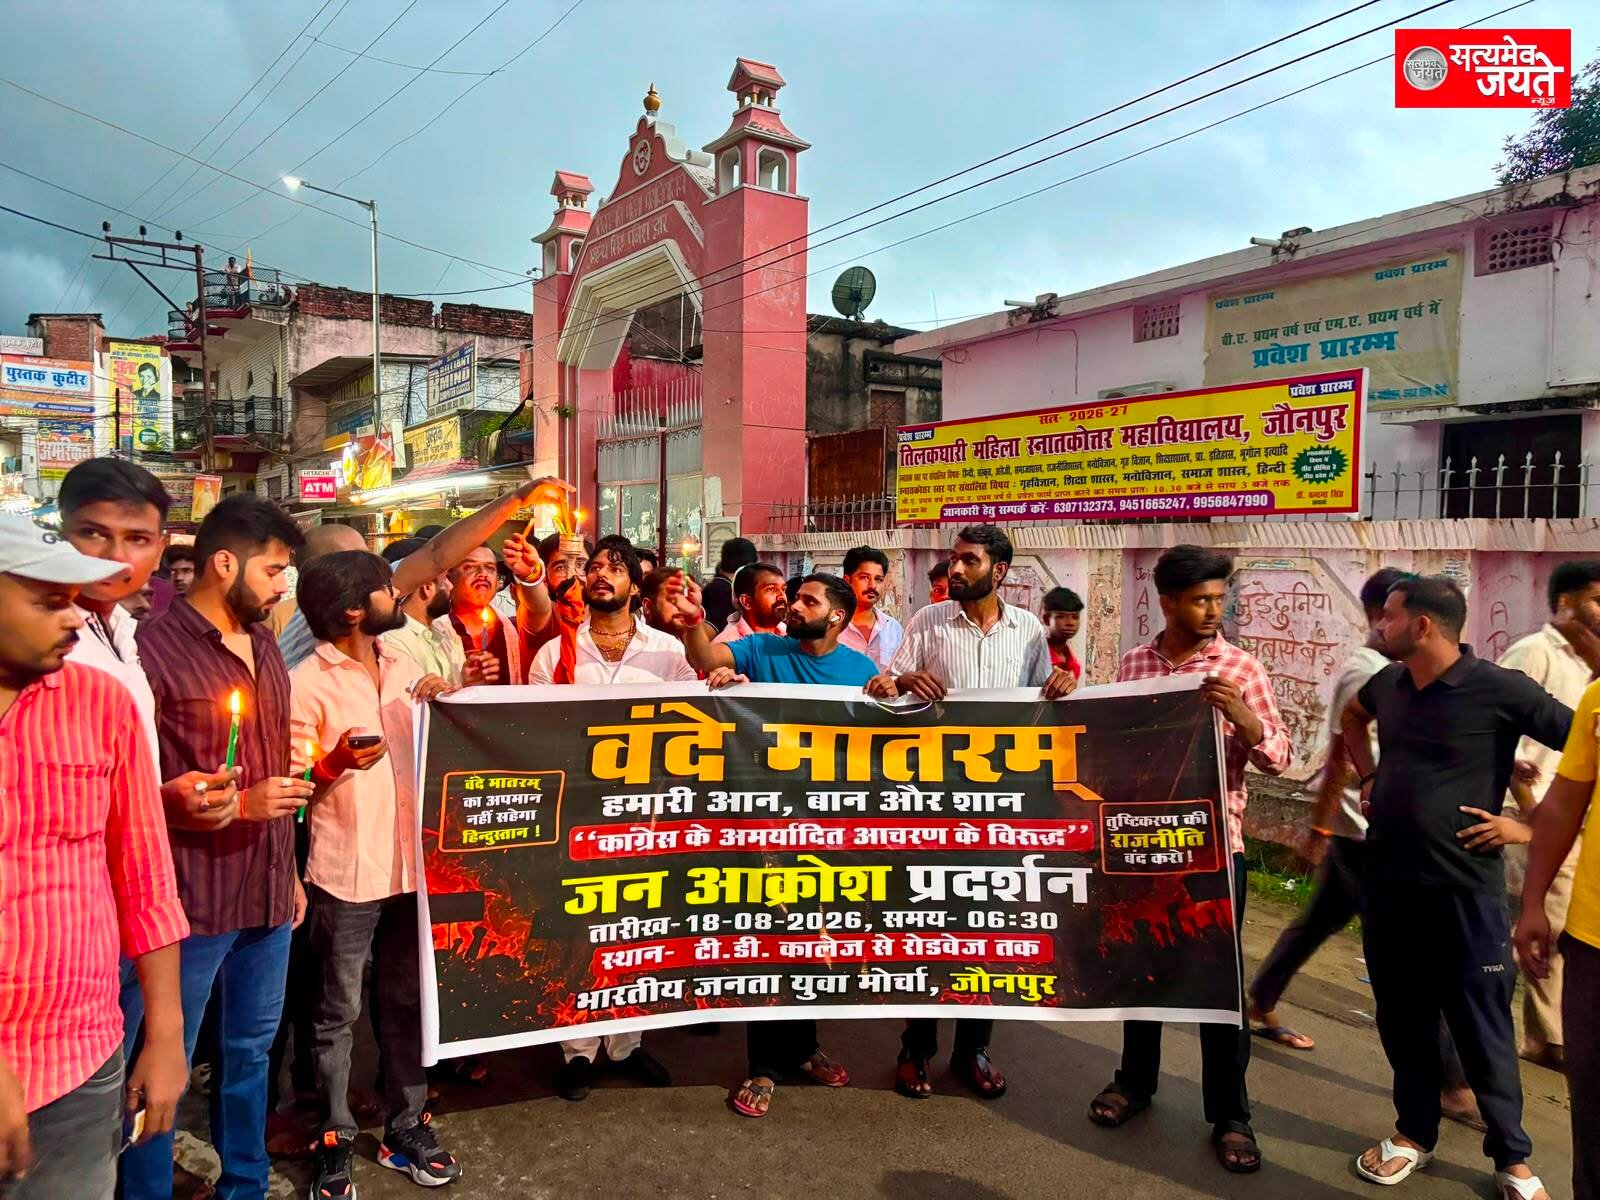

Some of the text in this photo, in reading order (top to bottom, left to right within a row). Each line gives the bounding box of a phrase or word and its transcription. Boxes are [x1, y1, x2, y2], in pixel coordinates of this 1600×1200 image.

[1252, 342, 1311, 369] प्रवेश
[5, 366, 88, 386] पुस्तक कुटीर
[1290, 383, 1316, 397] प्रवेश
[1069, 406, 1128, 421] 2026-27
[972, 434, 1021, 460] महिला
[1027, 425, 1114, 456] स्नातकोत्तर
[1120, 415, 1250, 446] महाविद्यालय,
[1262, 403, 1349, 441] जौनपुर
[1181, 468, 1213, 479] समाज
[1257, 461, 1286, 475] हिन्दी
[304, 482, 333, 493] ATM
[943, 505, 979, 517] जानकारी
[982, 504, 995, 518] हेतु
[998, 502, 1027, 515] सम्पर्क
[1053, 500, 1116, 513] 6307132373,
[1119, 497, 1190, 511] 9451665247,
[1193, 494, 1268, 508] 9956847990
[1136, 586, 1149, 610] A
[1491, 601, 1508, 627] A
[1137, 614, 1150, 637] B
[587, 702, 1104, 800] वंदे मातरम्
[464, 775, 541, 791] वंदे मातरम्
[463, 793, 543, 808] का अपमान
[601, 785, 1025, 817] हमारी आन, बान और शान
[466, 808, 537, 826] नहीं सहेगा
[1105, 810, 1208, 832] तुष्टिकरण की
[463, 827, 529, 846] हिन्दुस्तान
[684, 824, 712, 846] के
[719, 823, 846, 847] अमर्यादित
[853, 826, 949, 845] आचरण
[953, 822, 981, 844] के
[1110, 827, 1205, 848] राजनीति
[1123, 849, 1147, 865] बंद
[562, 854, 1092, 915] जन आक्रोश प्रदर्शन
[882, 910, 957, 928] समय-
[967, 910, 1058, 930] 06:30
[601, 944, 675, 970] स्थान-
[778, 934, 865, 958] कालेज
[871, 933, 895, 957] से
[901, 933, 987, 957] रोडवेज
[994, 939, 1040, 958] तक
[576, 966, 1057, 1011] भारतीय जनता युवा मोर्चा, जौनपुर
